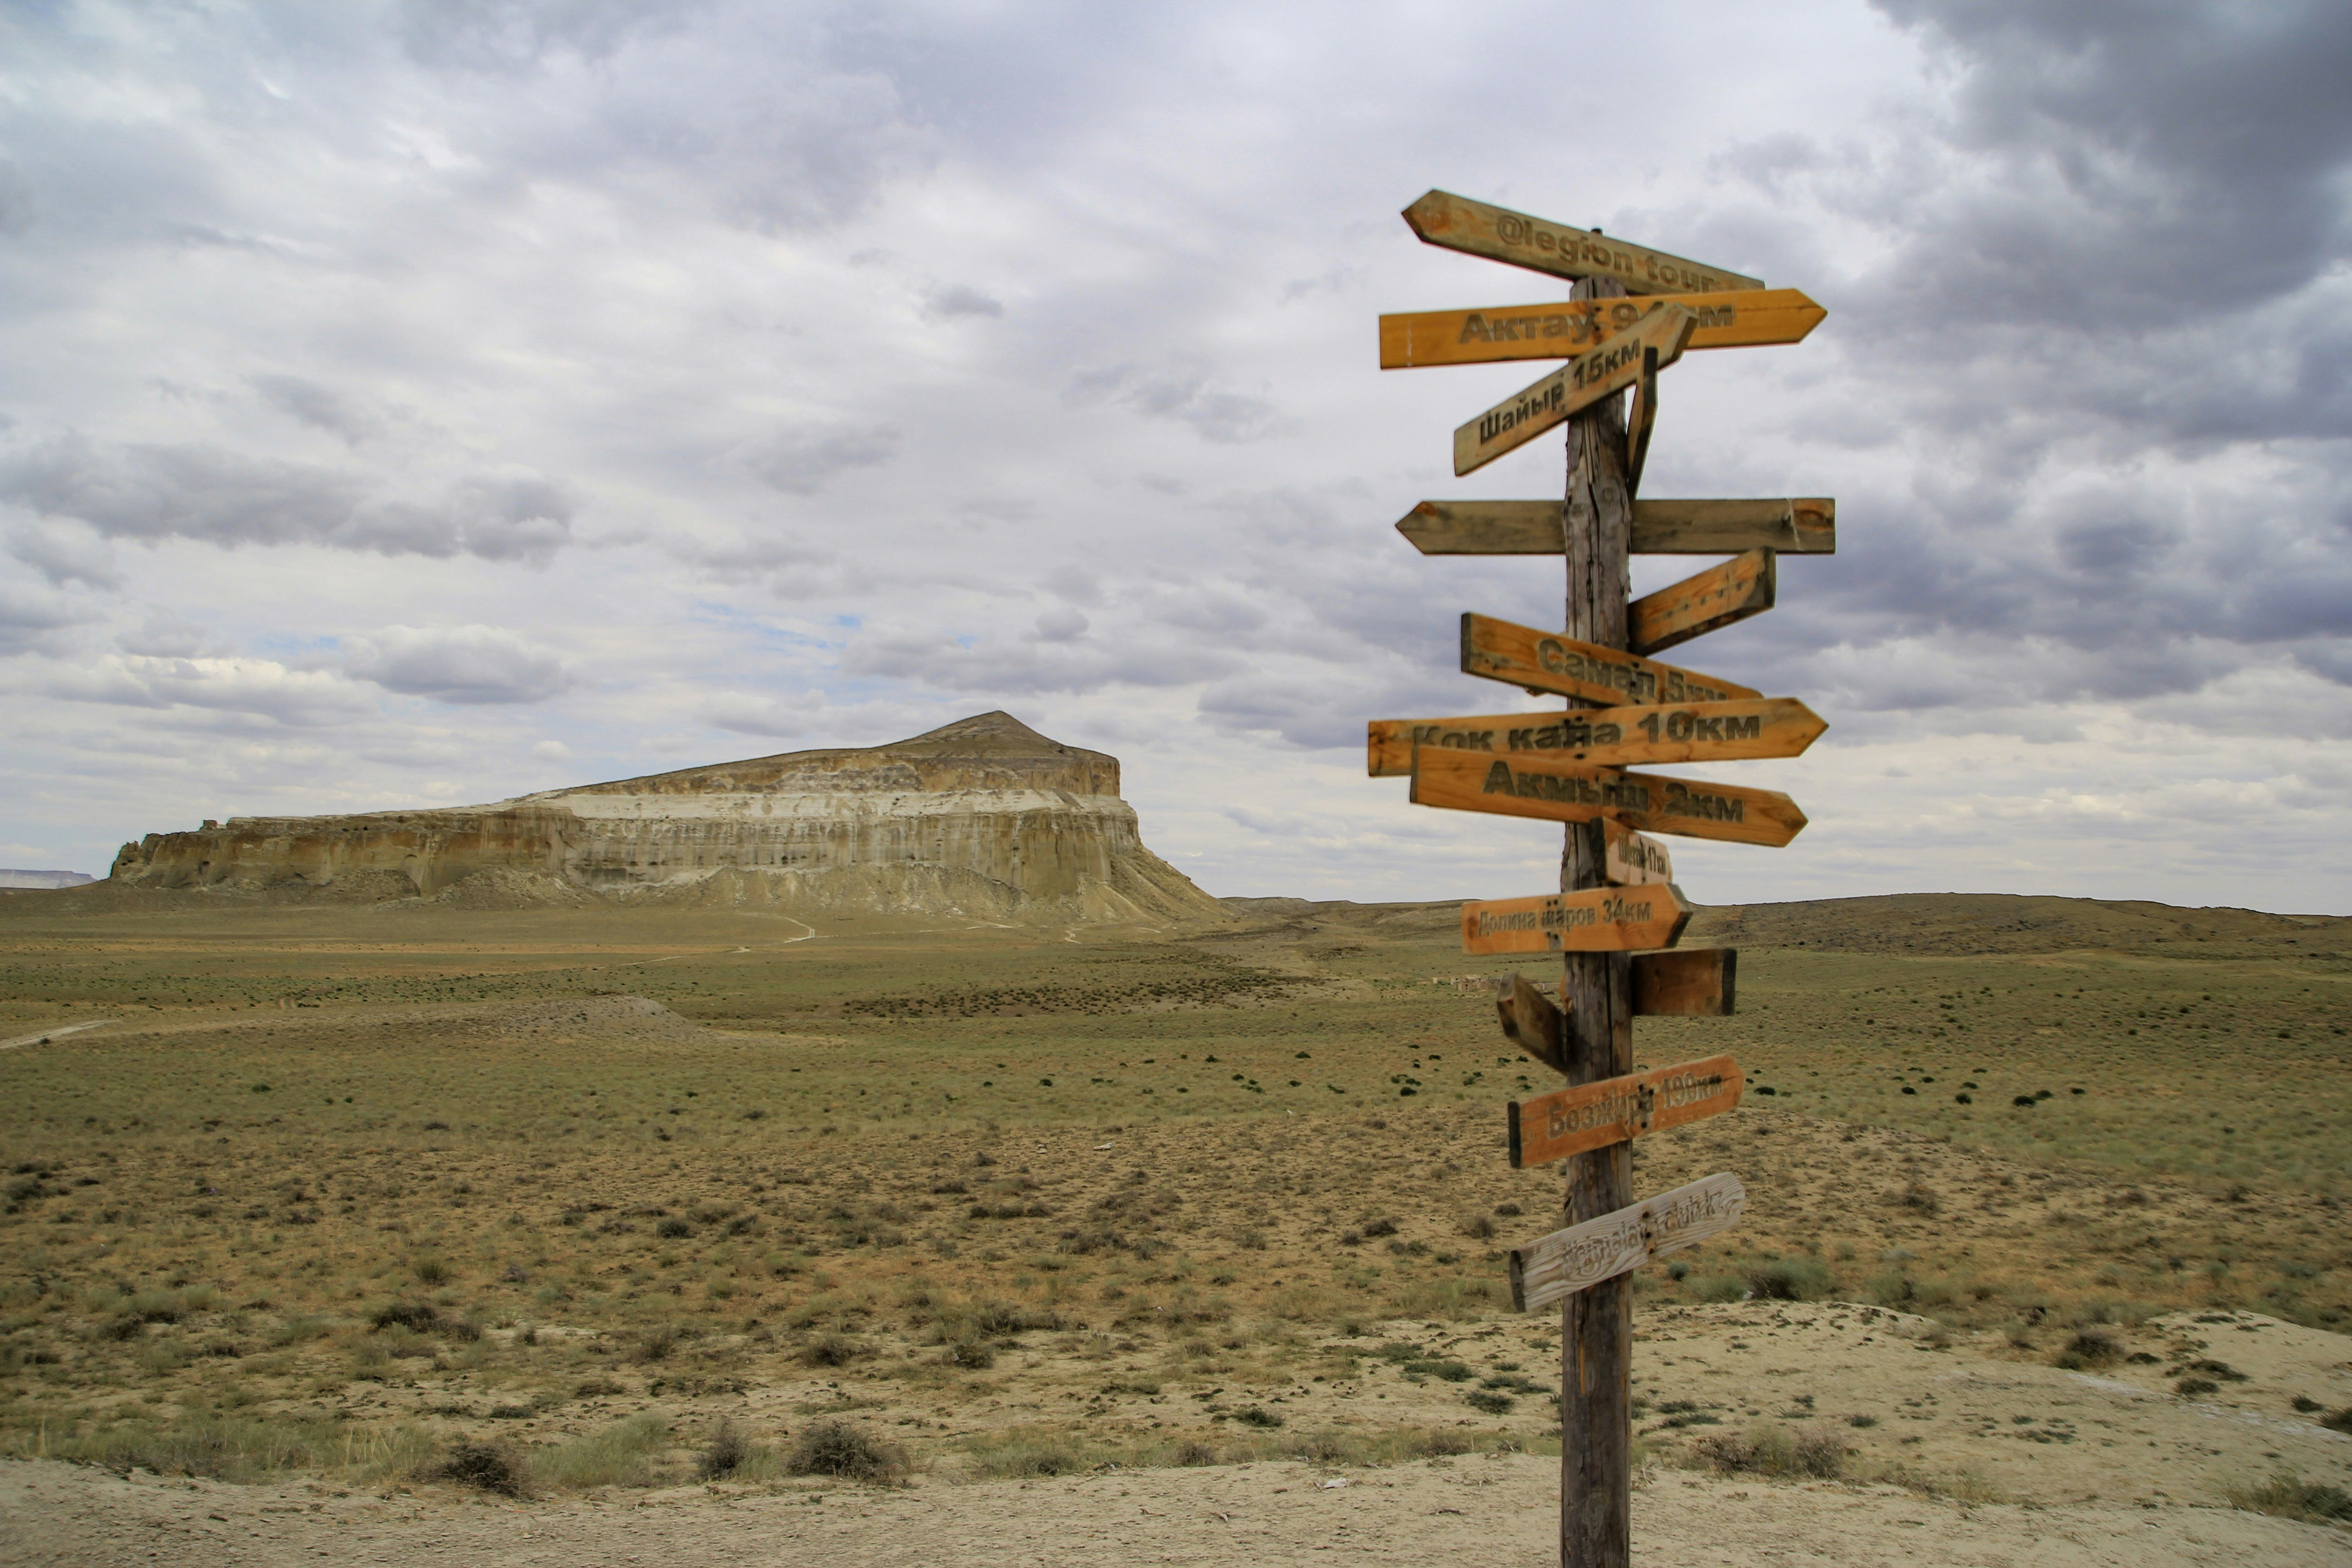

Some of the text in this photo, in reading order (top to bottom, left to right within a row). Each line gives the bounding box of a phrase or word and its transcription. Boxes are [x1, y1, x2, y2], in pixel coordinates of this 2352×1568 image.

[1459, 302, 1735, 345] Актау 9м
[1480, 338, 1641, 445] Шайыр 15км
[1413, 725, 1494, 751] Кок
[1637, 712, 1760, 743] 10км
[1482, 760, 1744, 823] Акмыш 2км
[1478, 898, 1652, 937] Долина шаров 34км
